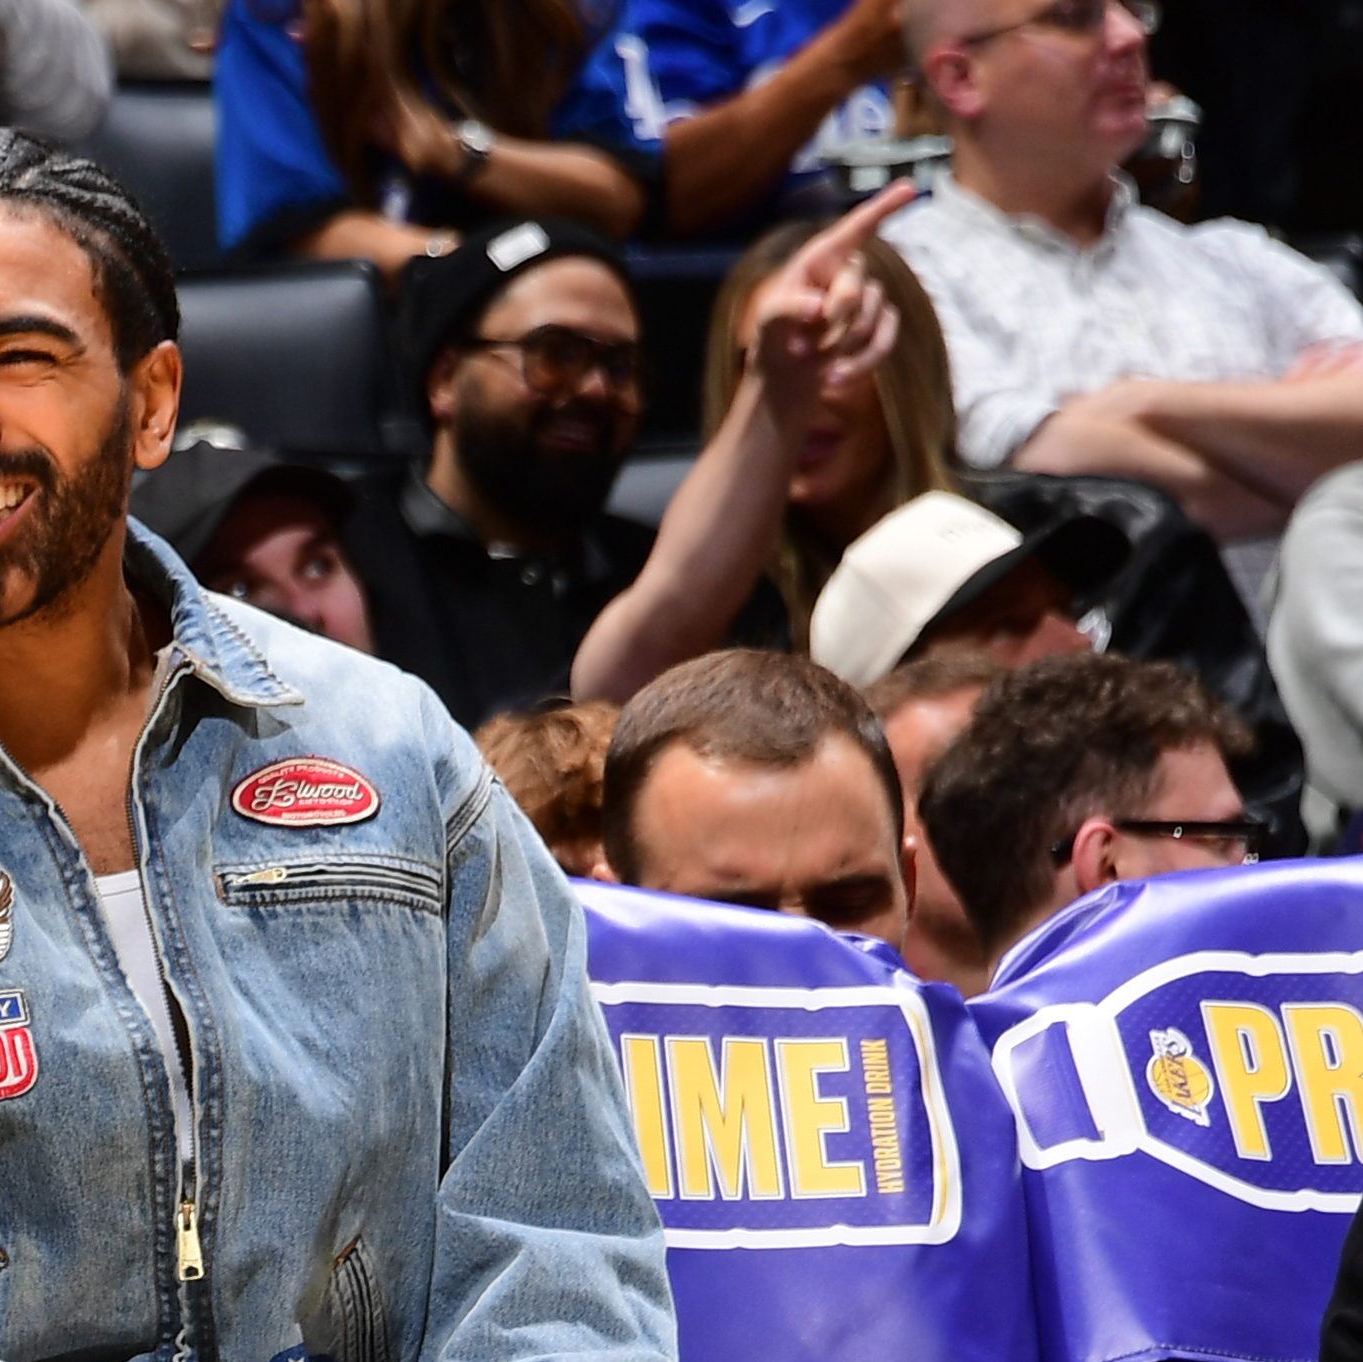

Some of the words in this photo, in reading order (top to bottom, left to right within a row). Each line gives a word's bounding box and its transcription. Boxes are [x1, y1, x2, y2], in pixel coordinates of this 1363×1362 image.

[251, 778, 364, 811] Elwood
[859, 1038, 893, 1094] DRINK
[867, 1097, 905, 1194] HYDRATION
